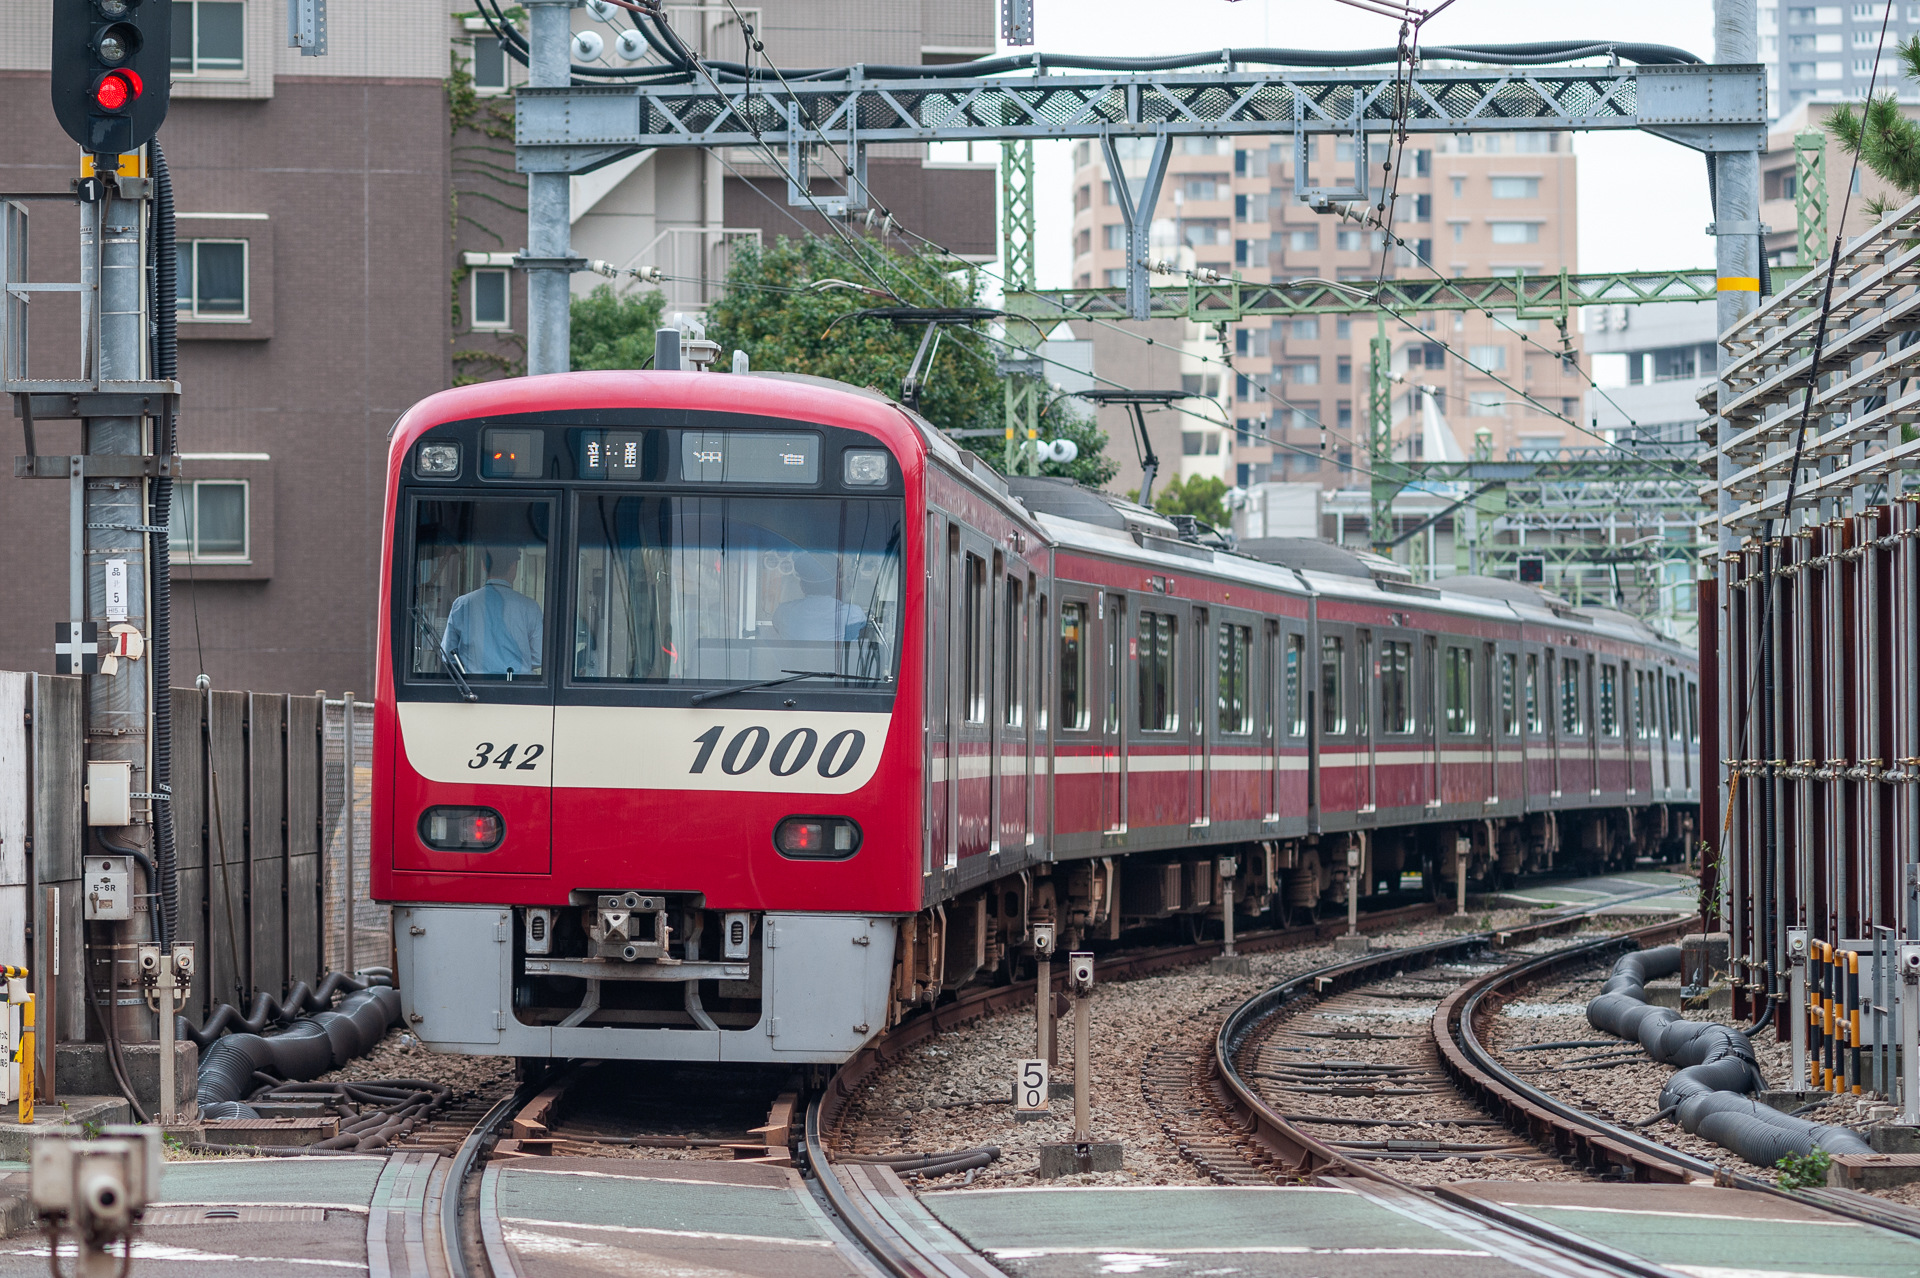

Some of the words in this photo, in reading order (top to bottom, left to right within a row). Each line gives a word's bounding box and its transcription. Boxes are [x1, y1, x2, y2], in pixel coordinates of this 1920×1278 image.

[85, 180, 95, 201] 1
[467, 742, 545, 771] 342
[688, 725, 866, 779] 1000
